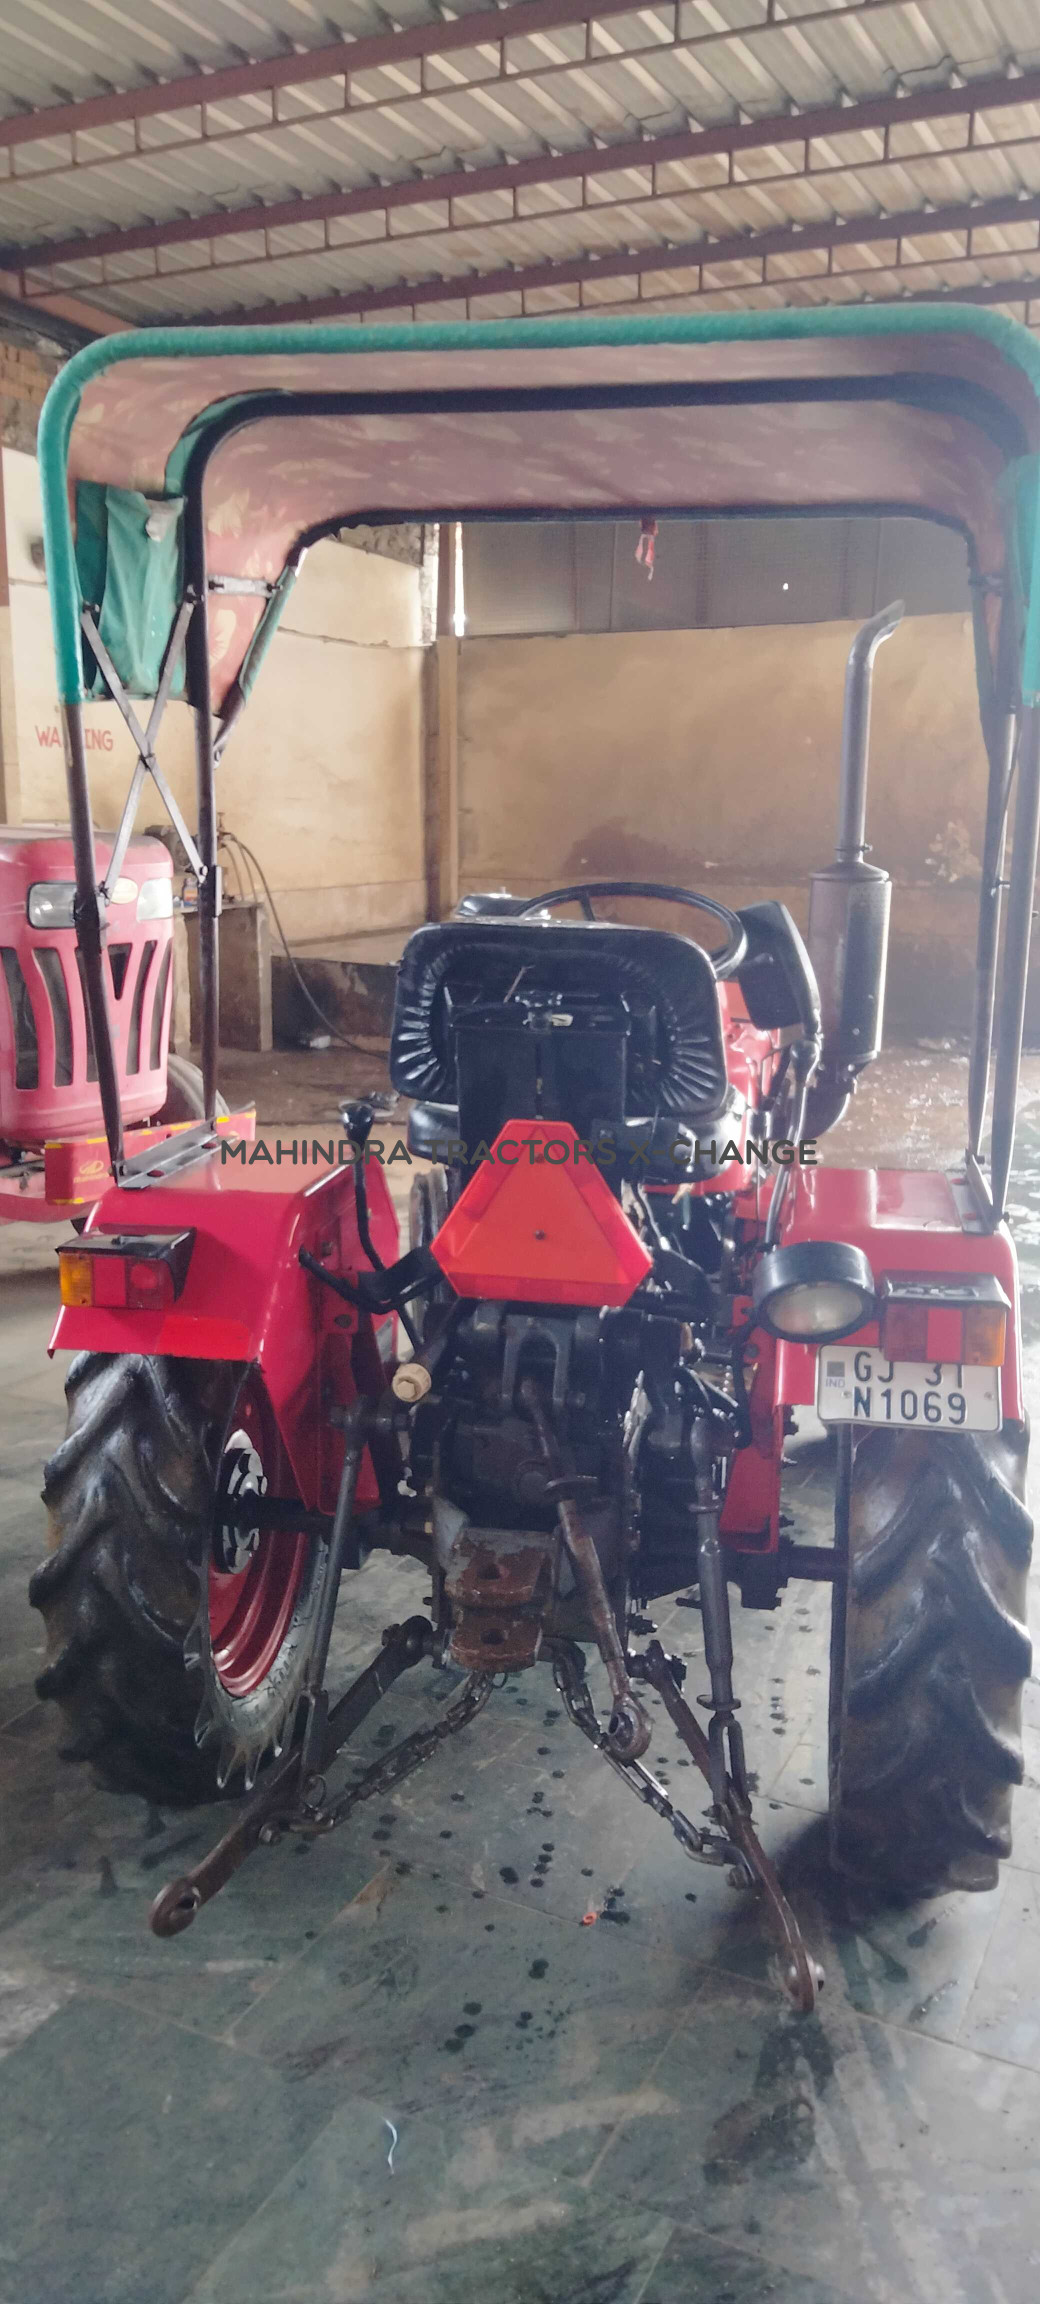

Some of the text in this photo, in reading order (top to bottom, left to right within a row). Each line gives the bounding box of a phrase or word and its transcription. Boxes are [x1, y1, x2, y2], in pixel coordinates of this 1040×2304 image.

[35, 725, 113, 751] WAING
[854, 1351, 894, 1383] GJ
[825, 1378, 845, 1388] IND
[854, 1386, 966, 1425] N1069
